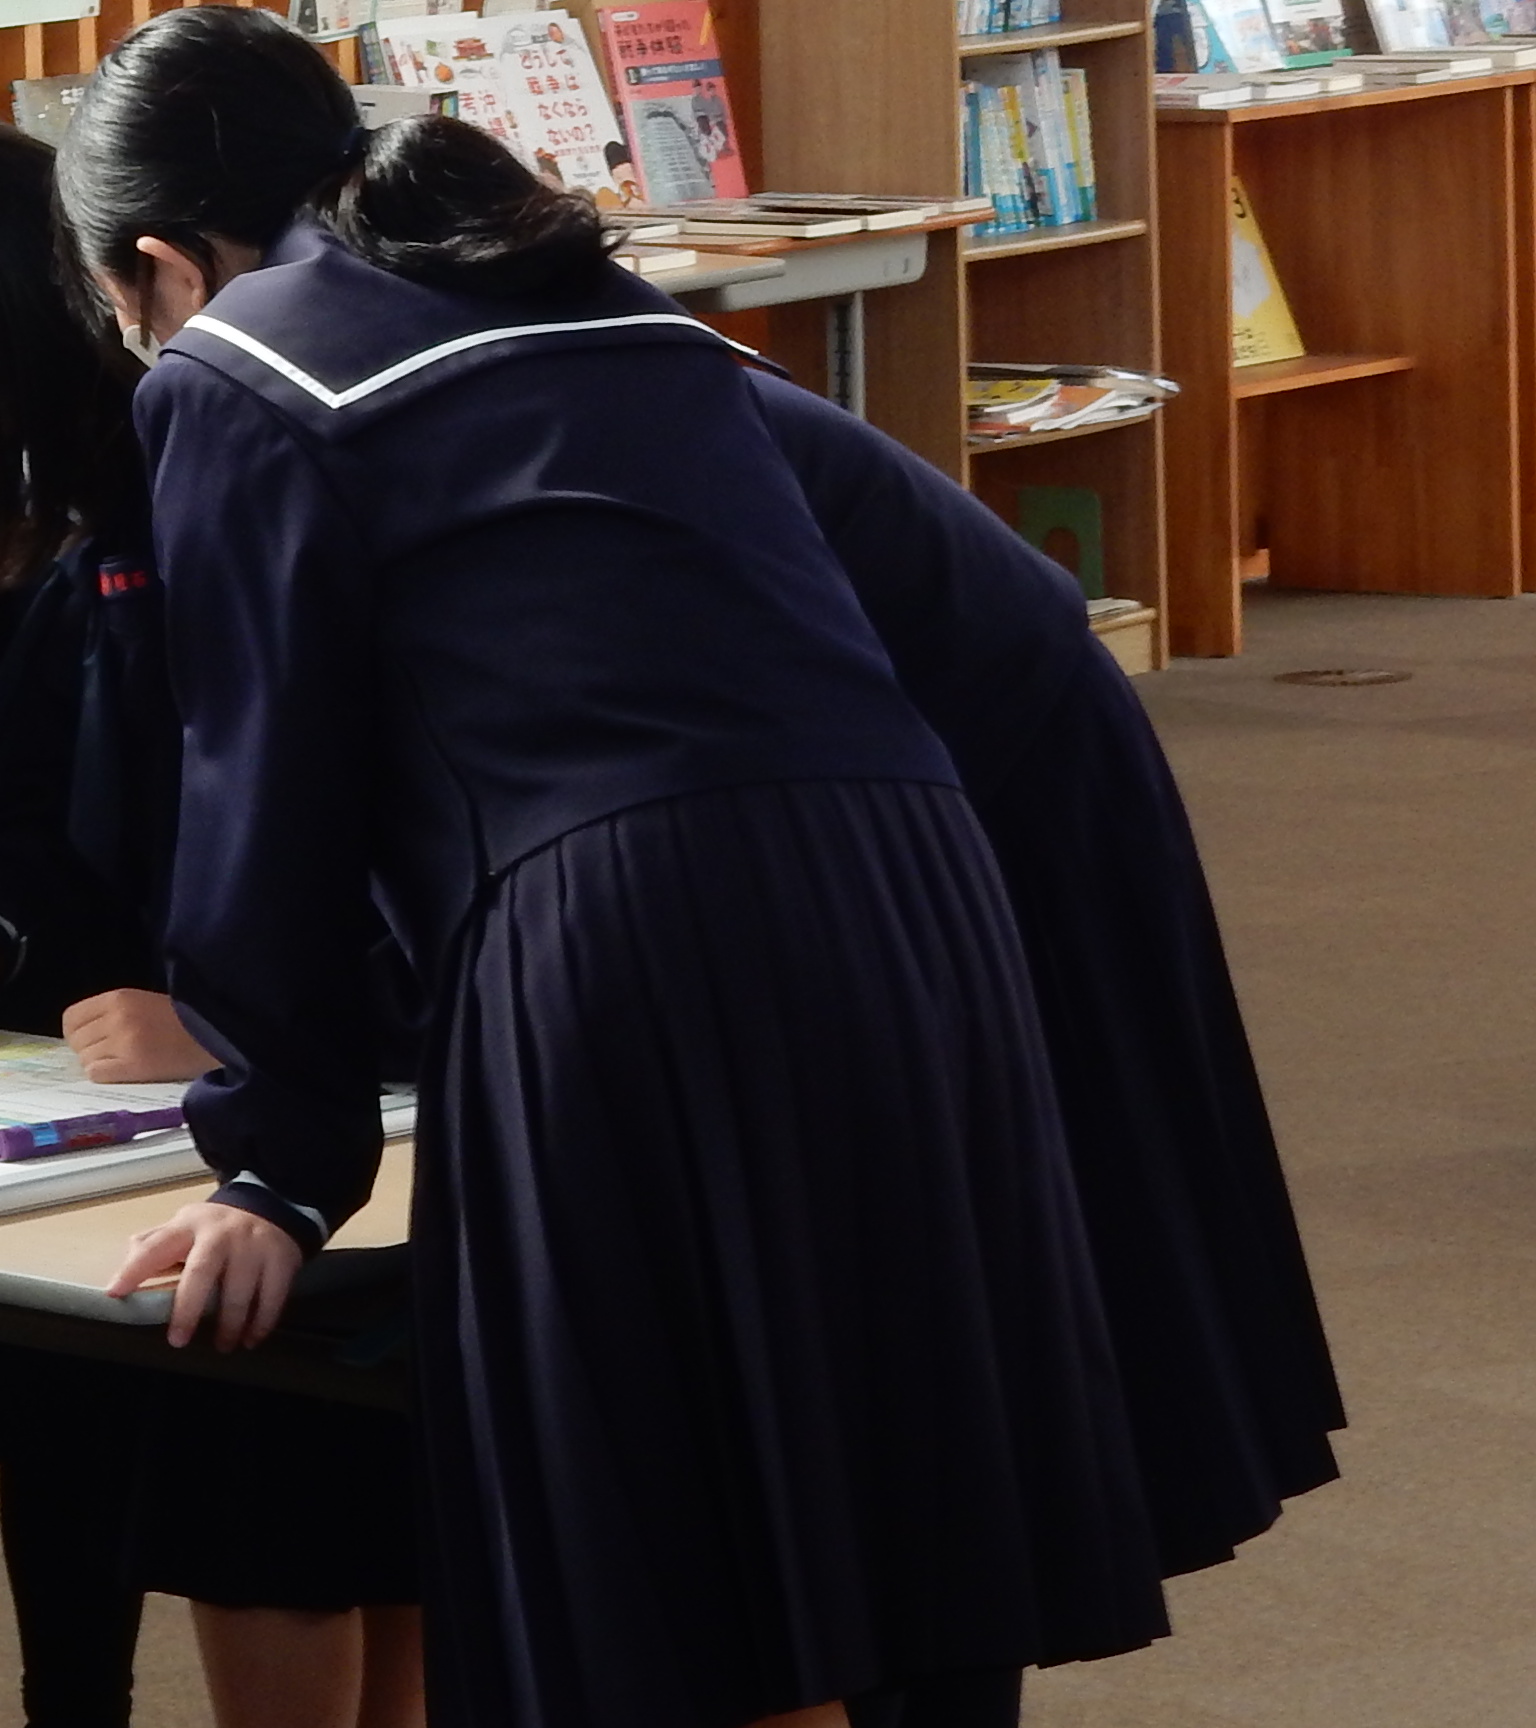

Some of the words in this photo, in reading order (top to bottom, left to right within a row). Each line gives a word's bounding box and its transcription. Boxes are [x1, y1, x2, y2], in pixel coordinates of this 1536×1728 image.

[518, 48, 576, 69] どうして
[525, 74, 580, 96] 戦争は
[536, 98, 589, 121] なくなら
